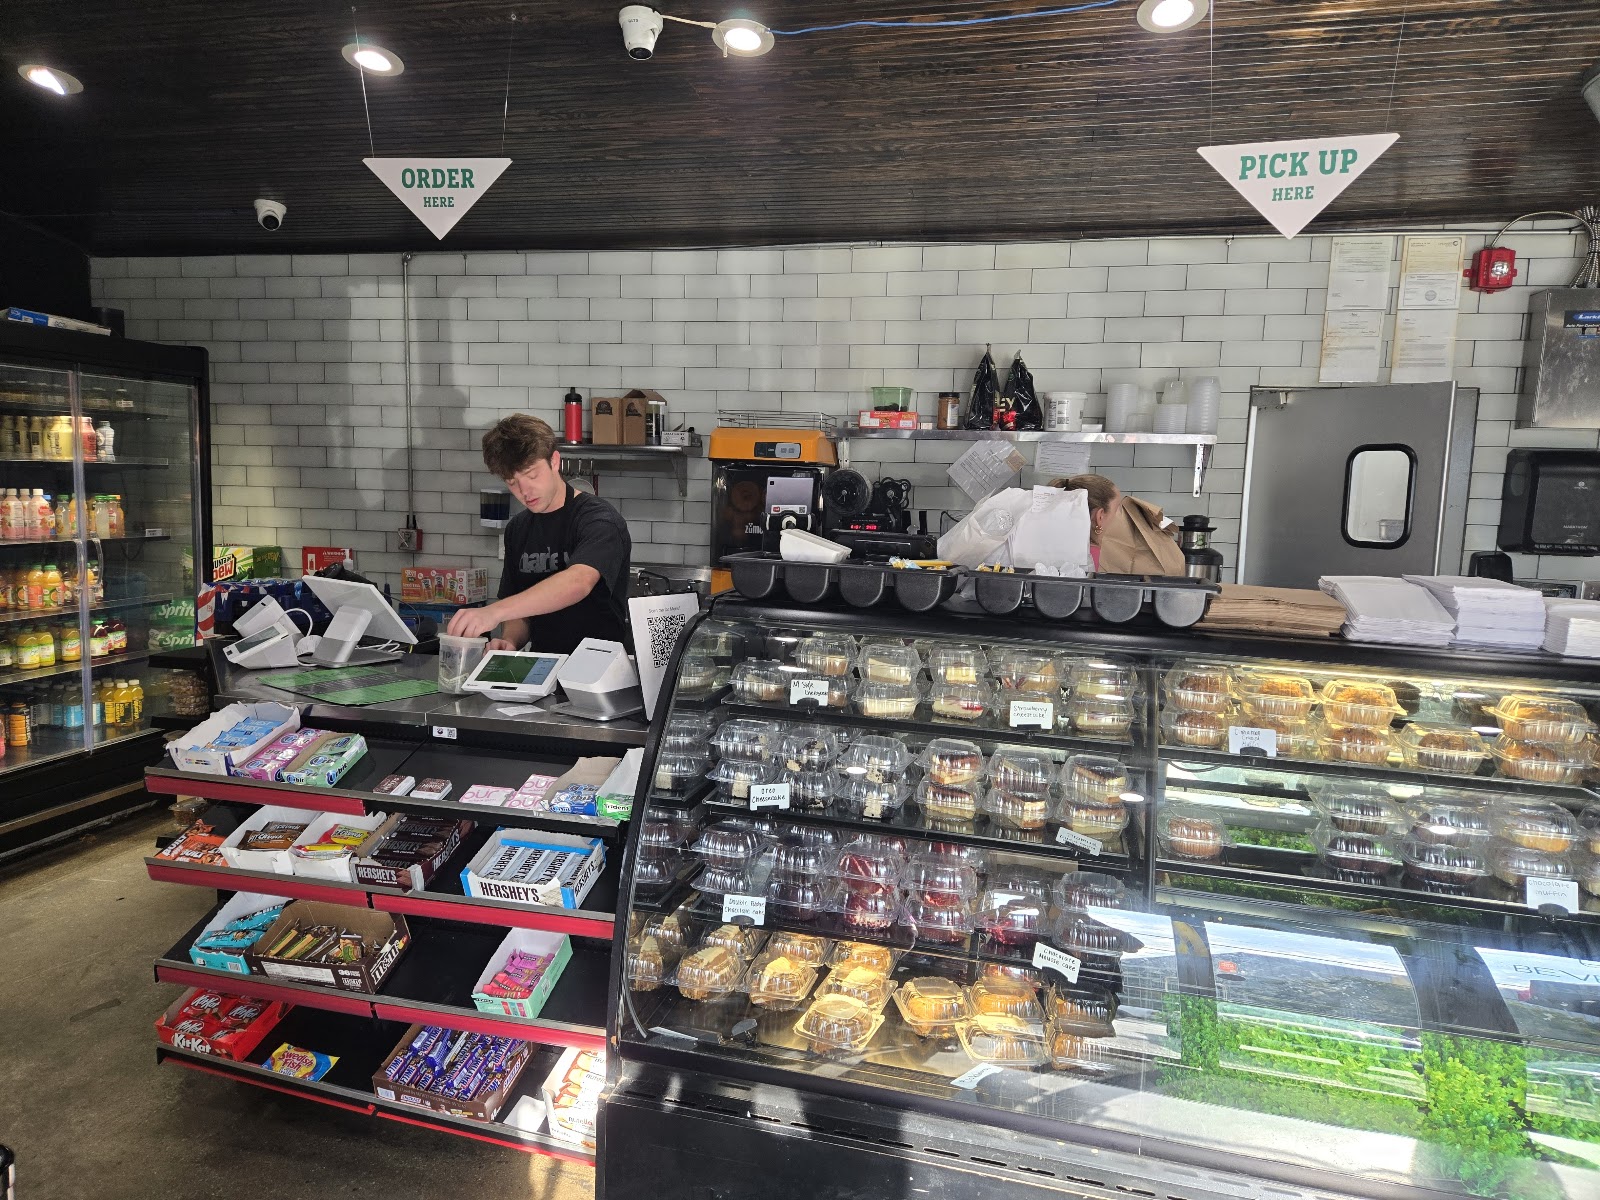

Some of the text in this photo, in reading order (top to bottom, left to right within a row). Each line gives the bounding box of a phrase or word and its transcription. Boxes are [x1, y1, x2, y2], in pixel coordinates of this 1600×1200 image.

[1239, 148, 1358, 181] PICK UP
[401, 168, 475, 189] ORDER
[1271, 185, 1315, 201] HERE
[423, 196, 455, 208] HERE
[326, 762, 348, 785] Orbit
[603, 803, 630, 811] Trident
[357, 866, 397, 881] HERSHEY'S
[480, 881, 540, 902] HERSHEY'S
[278, 1050, 314, 1067] Swedish
[281, 1059, 302, 1071] Fish
